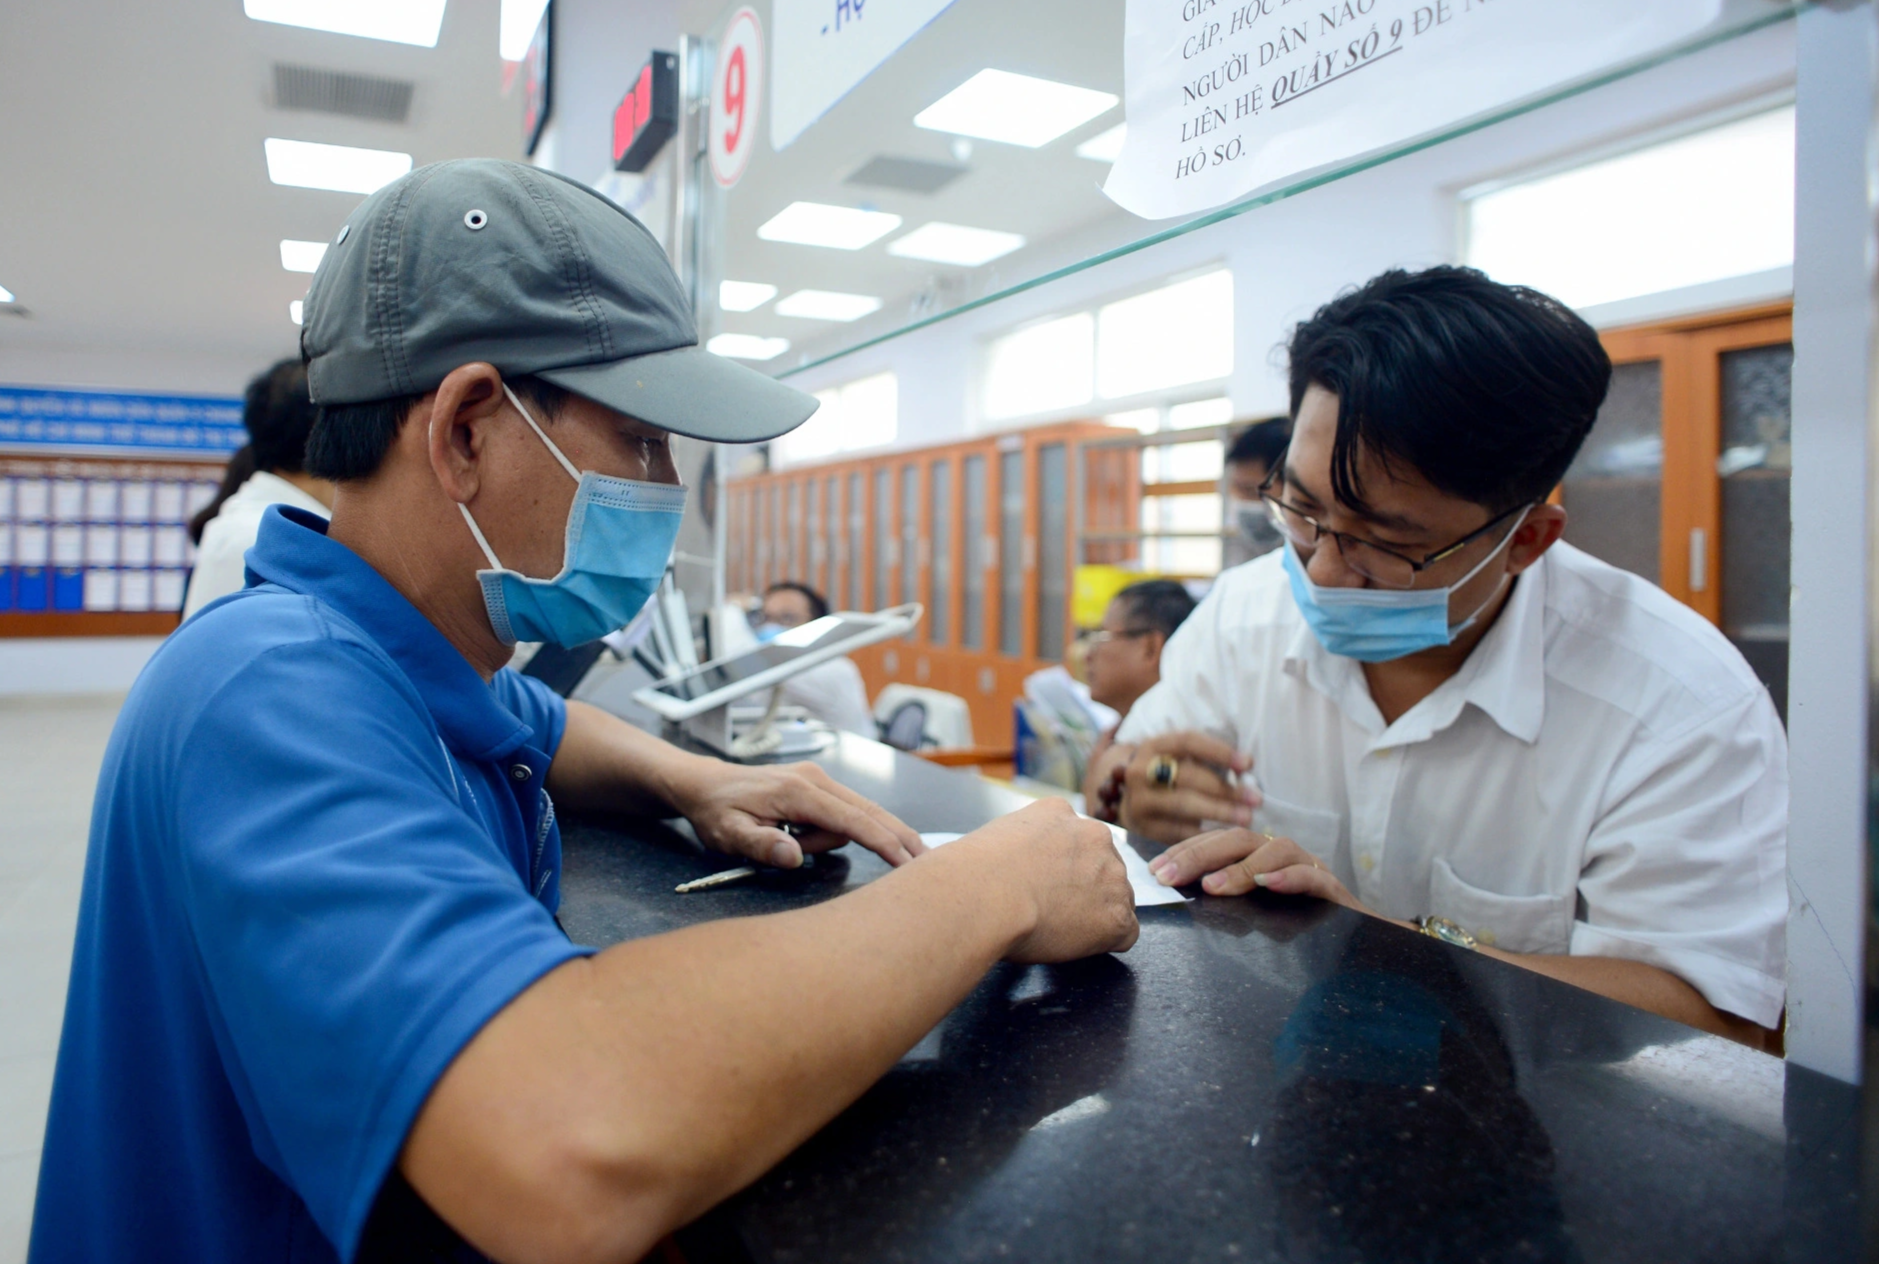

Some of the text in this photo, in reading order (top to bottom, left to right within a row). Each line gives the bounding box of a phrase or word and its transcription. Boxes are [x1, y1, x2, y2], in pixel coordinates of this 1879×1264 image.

[1230, 0, 1275, 35] HỌC
[723, 45, 747, 155] 9
[1180, 104, 1228, 143] LIÊN
[1235, 84, 1264, 120] HỆ
[1344, 22, 1379, 69] SỐ
[1389, 18, 1403, 48] 9
[1182, 52, 1249, 106] NGƯỜI
[1259, 21, 1308, 67] DÂN
[1212, 134, 1246, 166] SƠ.
